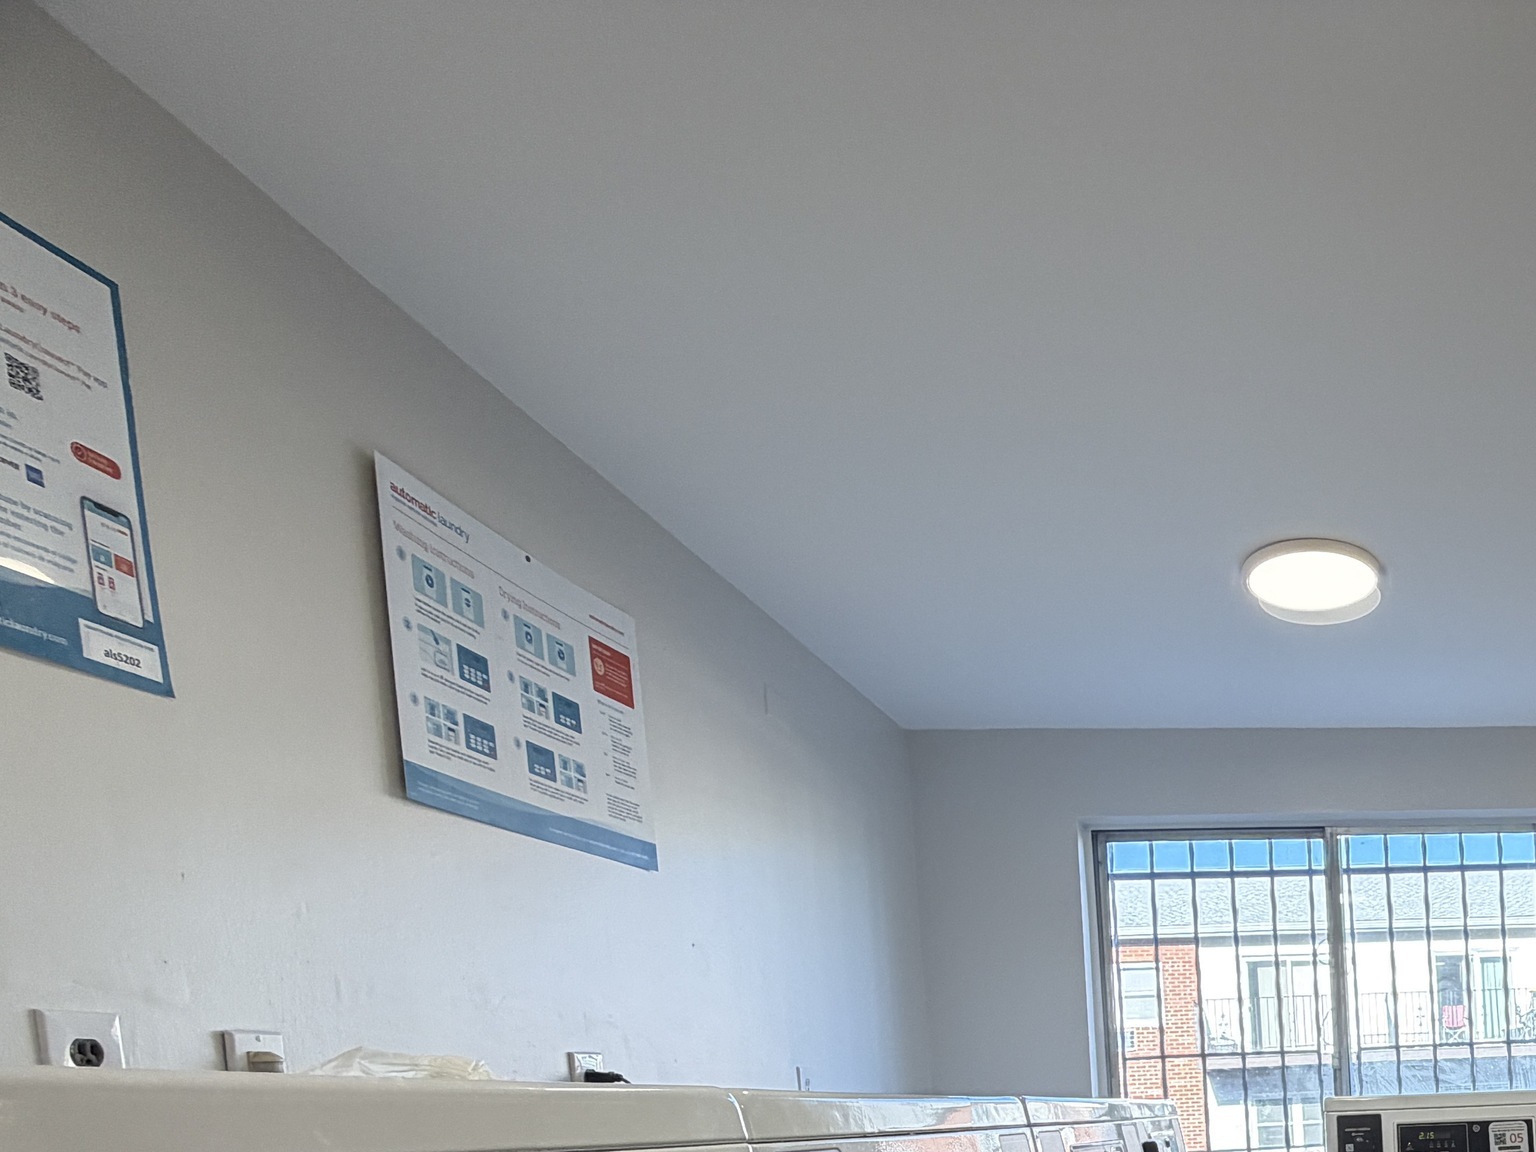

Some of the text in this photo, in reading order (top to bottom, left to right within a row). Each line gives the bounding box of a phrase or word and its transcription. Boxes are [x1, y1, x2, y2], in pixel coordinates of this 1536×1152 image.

[390, 481, 437, 520] automatic
[437, 511, 470, 544] laundry
[103, 648, 142, 669] als5202
[1509, 1133, 1524, 1143] 05
